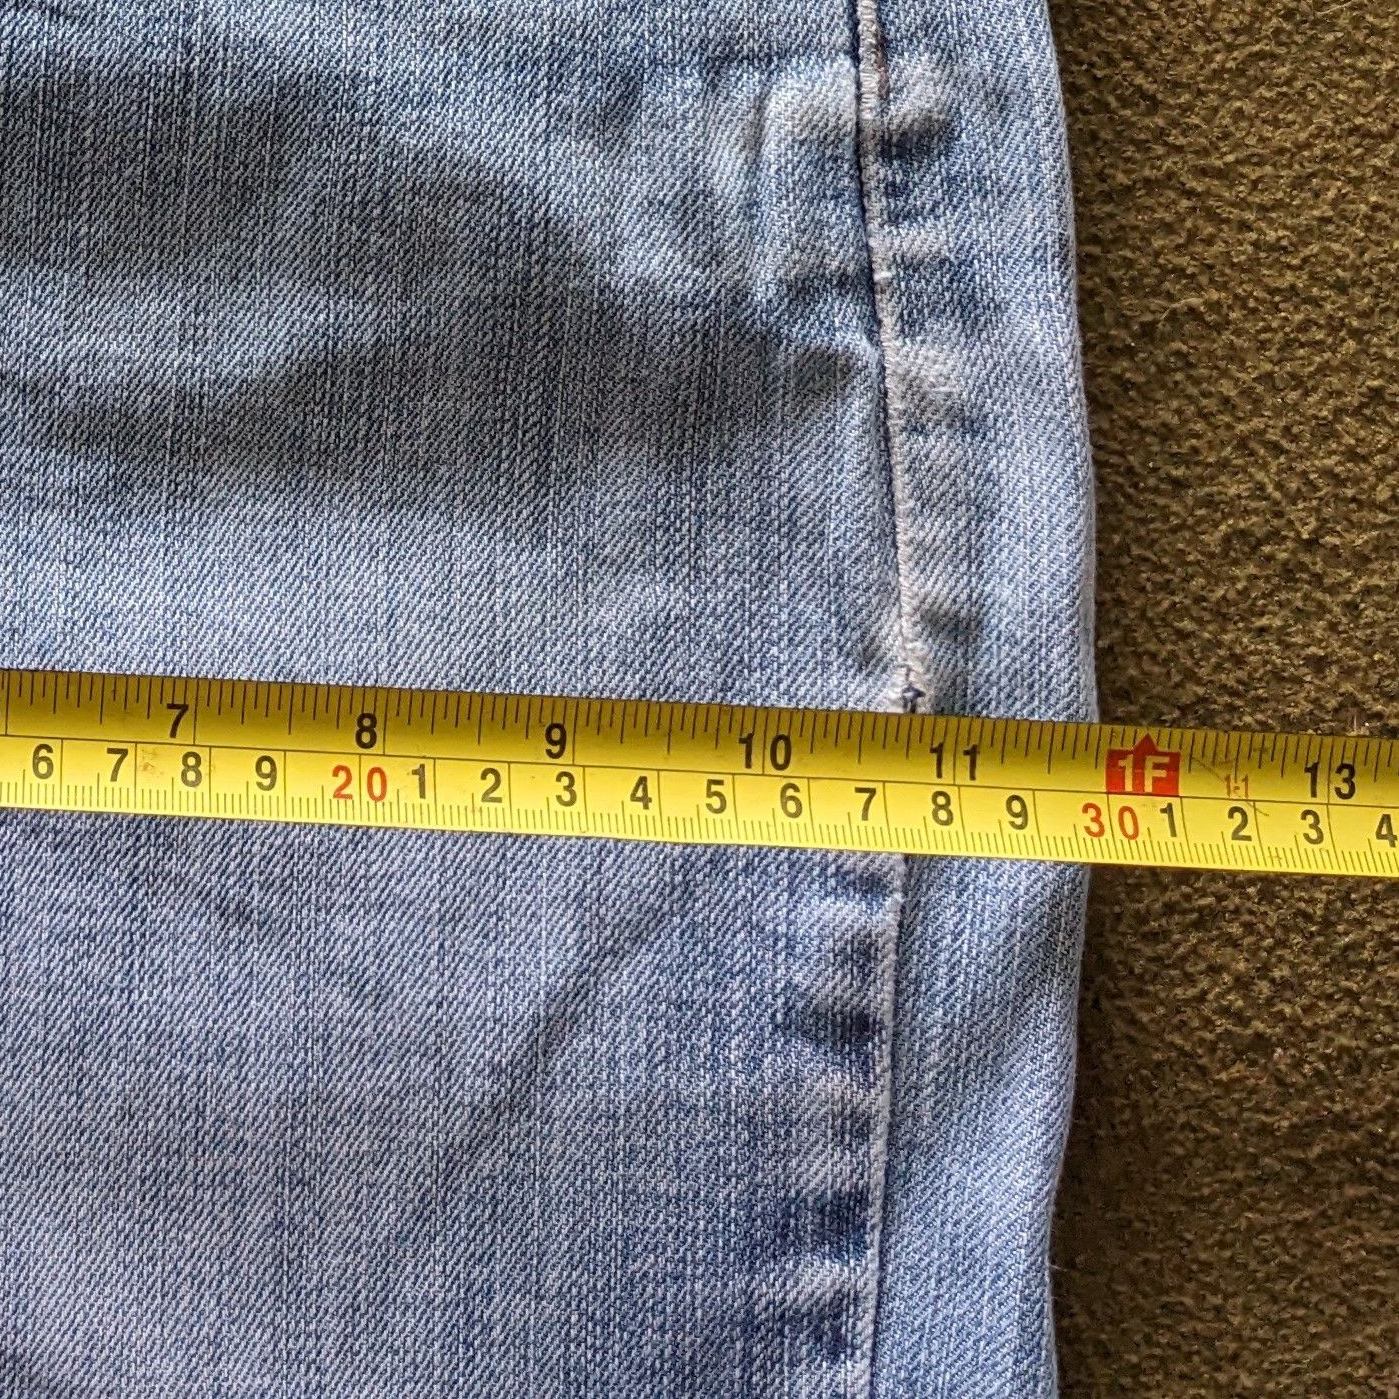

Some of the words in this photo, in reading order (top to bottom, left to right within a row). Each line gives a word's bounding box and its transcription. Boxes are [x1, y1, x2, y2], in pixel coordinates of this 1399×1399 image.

[31, 743, 55, 780] 6
[105, 747, 129, 783] 7
[180, 751, 203, 788] 8
[255, 755, 278, 792] 9
[331, 765, 388, 803] 20
[411, 763, 427, 800] 1
[480, 767, 503, 804] 2
[555, 771, 577, 807] 3
[629, 775, 653, 811] 4
[704, 778, 727, 814] 5
[779, 782, 803, 819] 6
[854, 786, 878, 822] 7
[931, 790, 954, 826] 8
[1005, 794, 1029, 831] 9
[1081, 802, 1139, 841] 30
[1159, 802, 1177, 838] 1
[1227, 805, 1252, 842] 2
[1300, 809, 1324, 846] 3
[1375, 813, 1399, 848] 4
[167, 703, 190, 739] 7
[355, 713, 378, 749] 8
[545, 723, 568, 759] 9
[738, 732, 792, 771] 10
[930, 742, 980, 781] 11
[1304, 761, 1357, 800] 13
